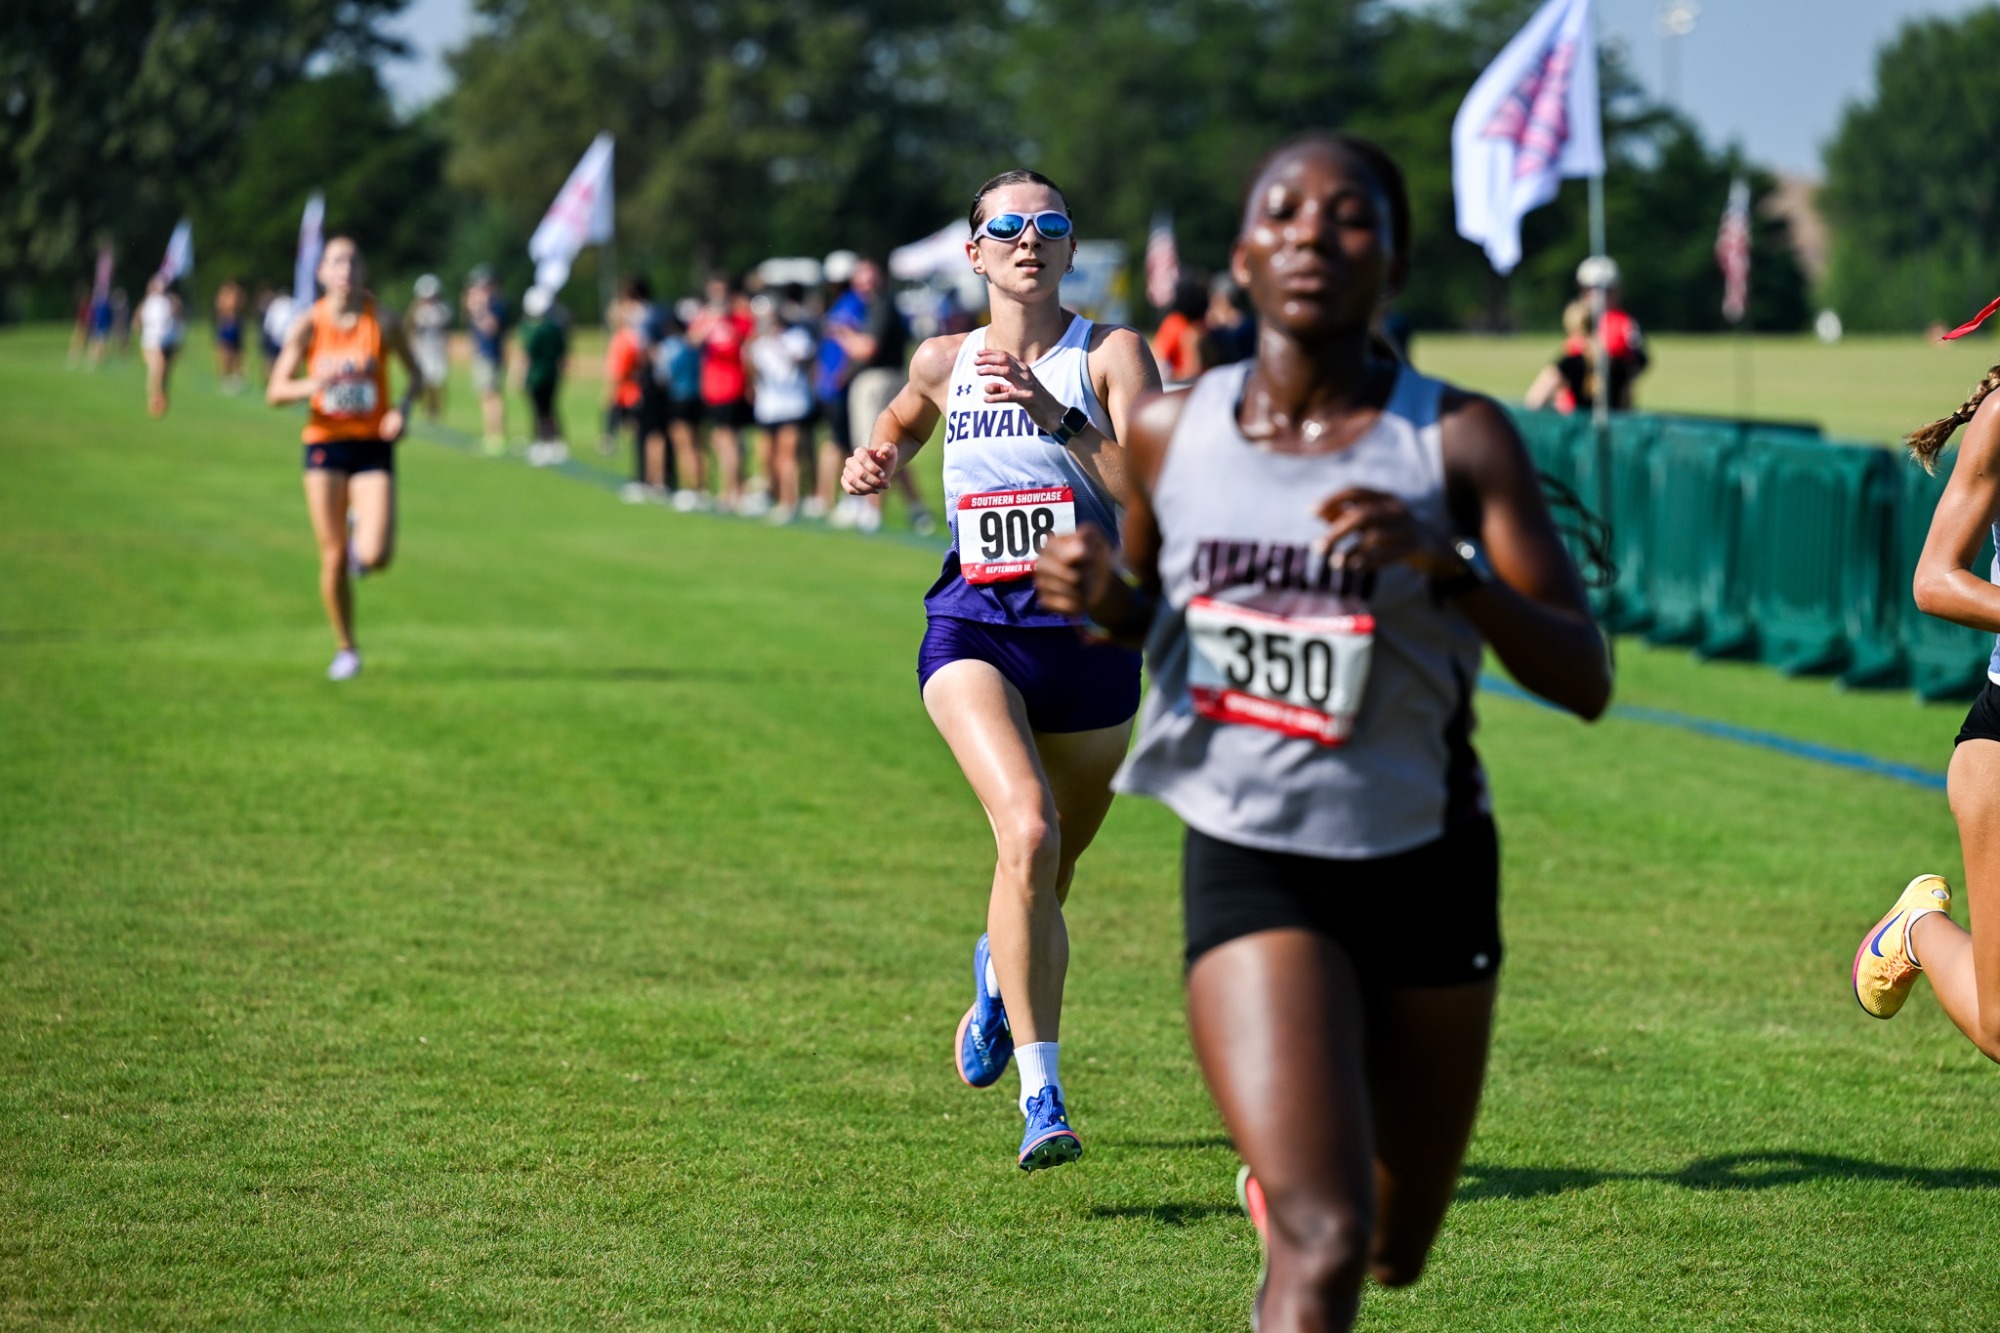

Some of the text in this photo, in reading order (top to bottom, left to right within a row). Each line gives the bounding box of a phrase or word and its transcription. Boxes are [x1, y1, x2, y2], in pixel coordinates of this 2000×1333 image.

[971, 491, 1062, 507] SOUTHERN SHOWCASE
[980, 507, 1055, 559] 908
[985, 565, 1022, 574] SEPTEMBER
[1225, 626, 1333, 704] 350
